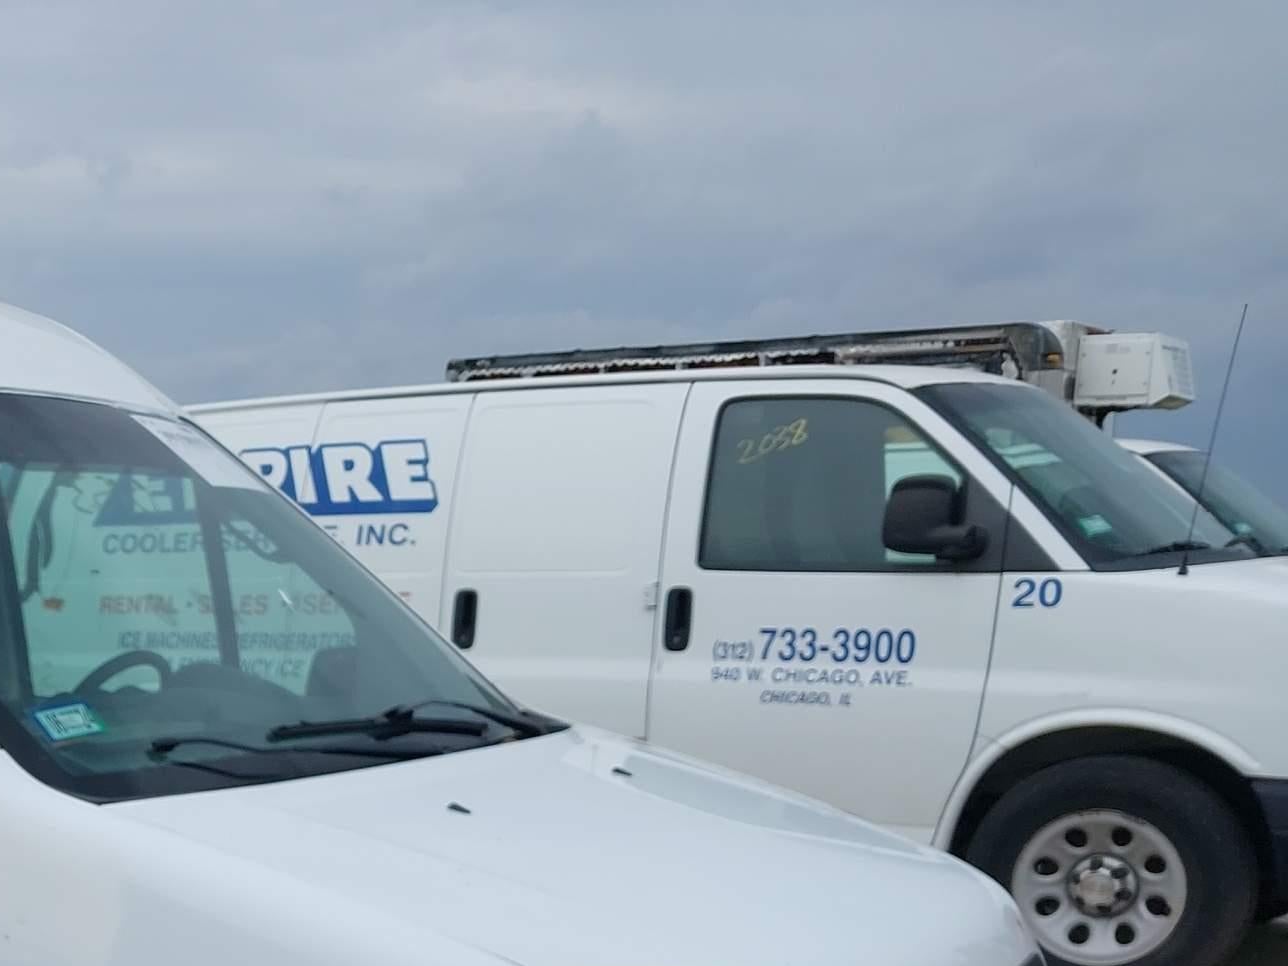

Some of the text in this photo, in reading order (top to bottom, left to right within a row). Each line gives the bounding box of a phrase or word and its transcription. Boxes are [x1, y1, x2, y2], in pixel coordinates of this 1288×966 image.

[1012, 578, 1064, 609] 20
[712, 628, 917, 664] (312) 733-3900
[711, 667, 742, 681] 940
